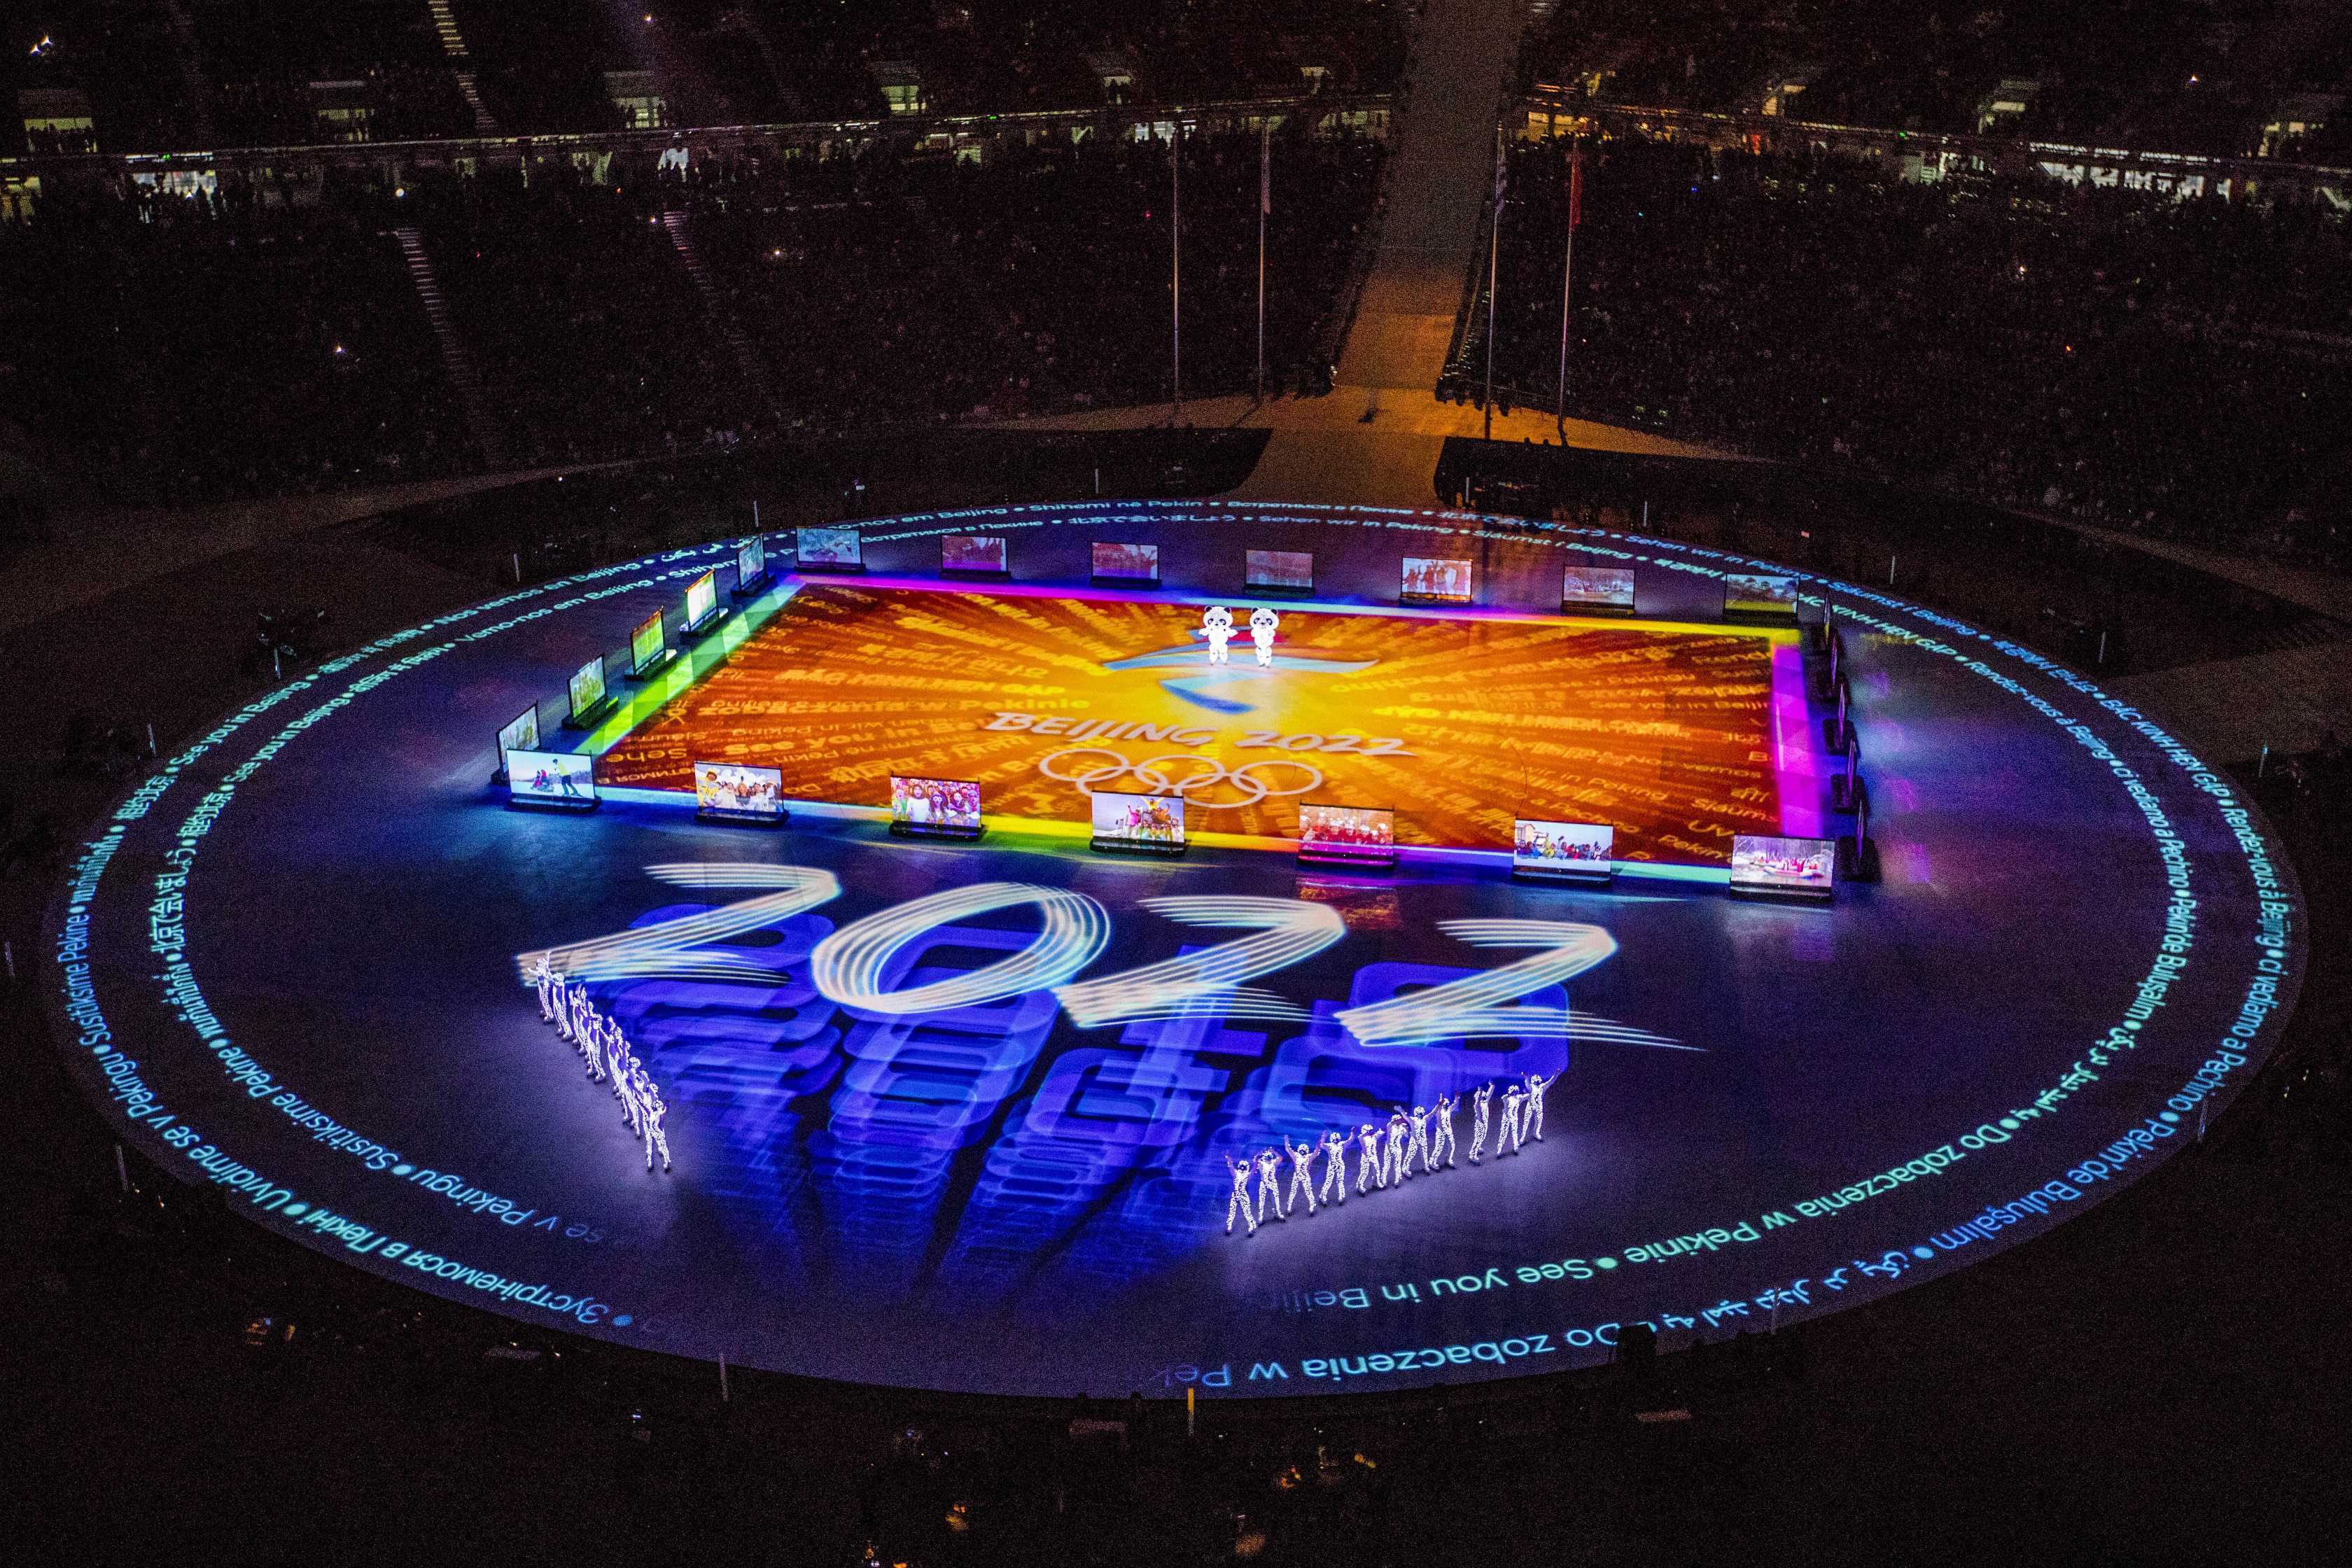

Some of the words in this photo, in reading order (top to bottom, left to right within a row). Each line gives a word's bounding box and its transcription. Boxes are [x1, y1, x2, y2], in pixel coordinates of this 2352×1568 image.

[901, 514, 934, 523] em
[937, 508, 1008, 519] Beijing
[1566, 542, 1634, 559] Beijing
[433, 609, 479, 624] Nos
[475, 589, 544, 610] vemos
[544, 580, 573, 590] en
[569, 562, 642, 582] Beijing
[454, 608, 553, 641] Vemo-nos
[553, 598, 587, 610] em
[584, 579, 654, 600] Beijing
[169, 745, 209, 765] See
[200, 724, 239, 744] you
[225, 713, 255, 724] in
[242, 681, 312, 713] Beijing
[1963, 661, 2064, 718] Rendez-vous
[2066, 725, 2116, 760] Beijing
[222, 762, 262, 782] See
[250, 741, 286, 761] you
[271, 730, 301, 740] in
[286, 698, 351, 729] Beijing
[983, 712, 1220, 746] BEIJING
[1236, 730, 1418, 757] 2022
[2131, 721, 2181, 748] KINH
[2112, 767, 2140, 778] ci
[112, 775, 178, 820] 相约北京
[176, 792, 234, 838] 相约北京
[2122, 780, 2170, 828] vediamo
[2152, 828, 2175, 838] a
[2220, 808, 2278, 888] Rendez-vous
[2158, 839, 2194, 888] Pechino
[148, 848, 197, 954] 北京で会いましょう
[56, 914, 90, 963] Pekine
[516, 862, 1704, 1052] 2022
[2258, 958, 2289, 975] ci
[61, 962, 112, 1046] Susitiksime
[2231, 975, 2279, 1037] vediamo
[2088, 1047, 2108, 1065] در
[2221, 1037, 2248, 1050] a
[99, 1053, 164, 1119] Pekingu
[217, 1046, 283, 1098] Pekine
[2167, 1050, 2247, 1111] Pechino
[146, 1115, 176, 1130] v
[162, 1126, 200, 1148] se
[271, 1093, 399, 1170] Susitiksime
[1959, 1124, 2012, 1149] Do
[187, 1145, 293, 1210] Uvidíme
[409, 1169, 535, 1225] Pekingu
[1794, 1144, 1966, 1217] zobaczenia
[296, 1209, 387, 1253] Пекіні
[533, 1216, 558, 1231] v
[1623, 1222, 1760, 1264] Pekinie
[1761, 1211, 1798, 1230] w
[379, 1242, 410, 1259] в
[1516, 1259, 1594, 1283] See
[1381, 1283, 1421, 1303] in
[1430, 1268, 1508, 1296] you
[1823, 1268, 1848, 1290] در
[1248, 1362, 1288, 1380] w
[1301, 1334, 1555, 1382] zobaczenia
